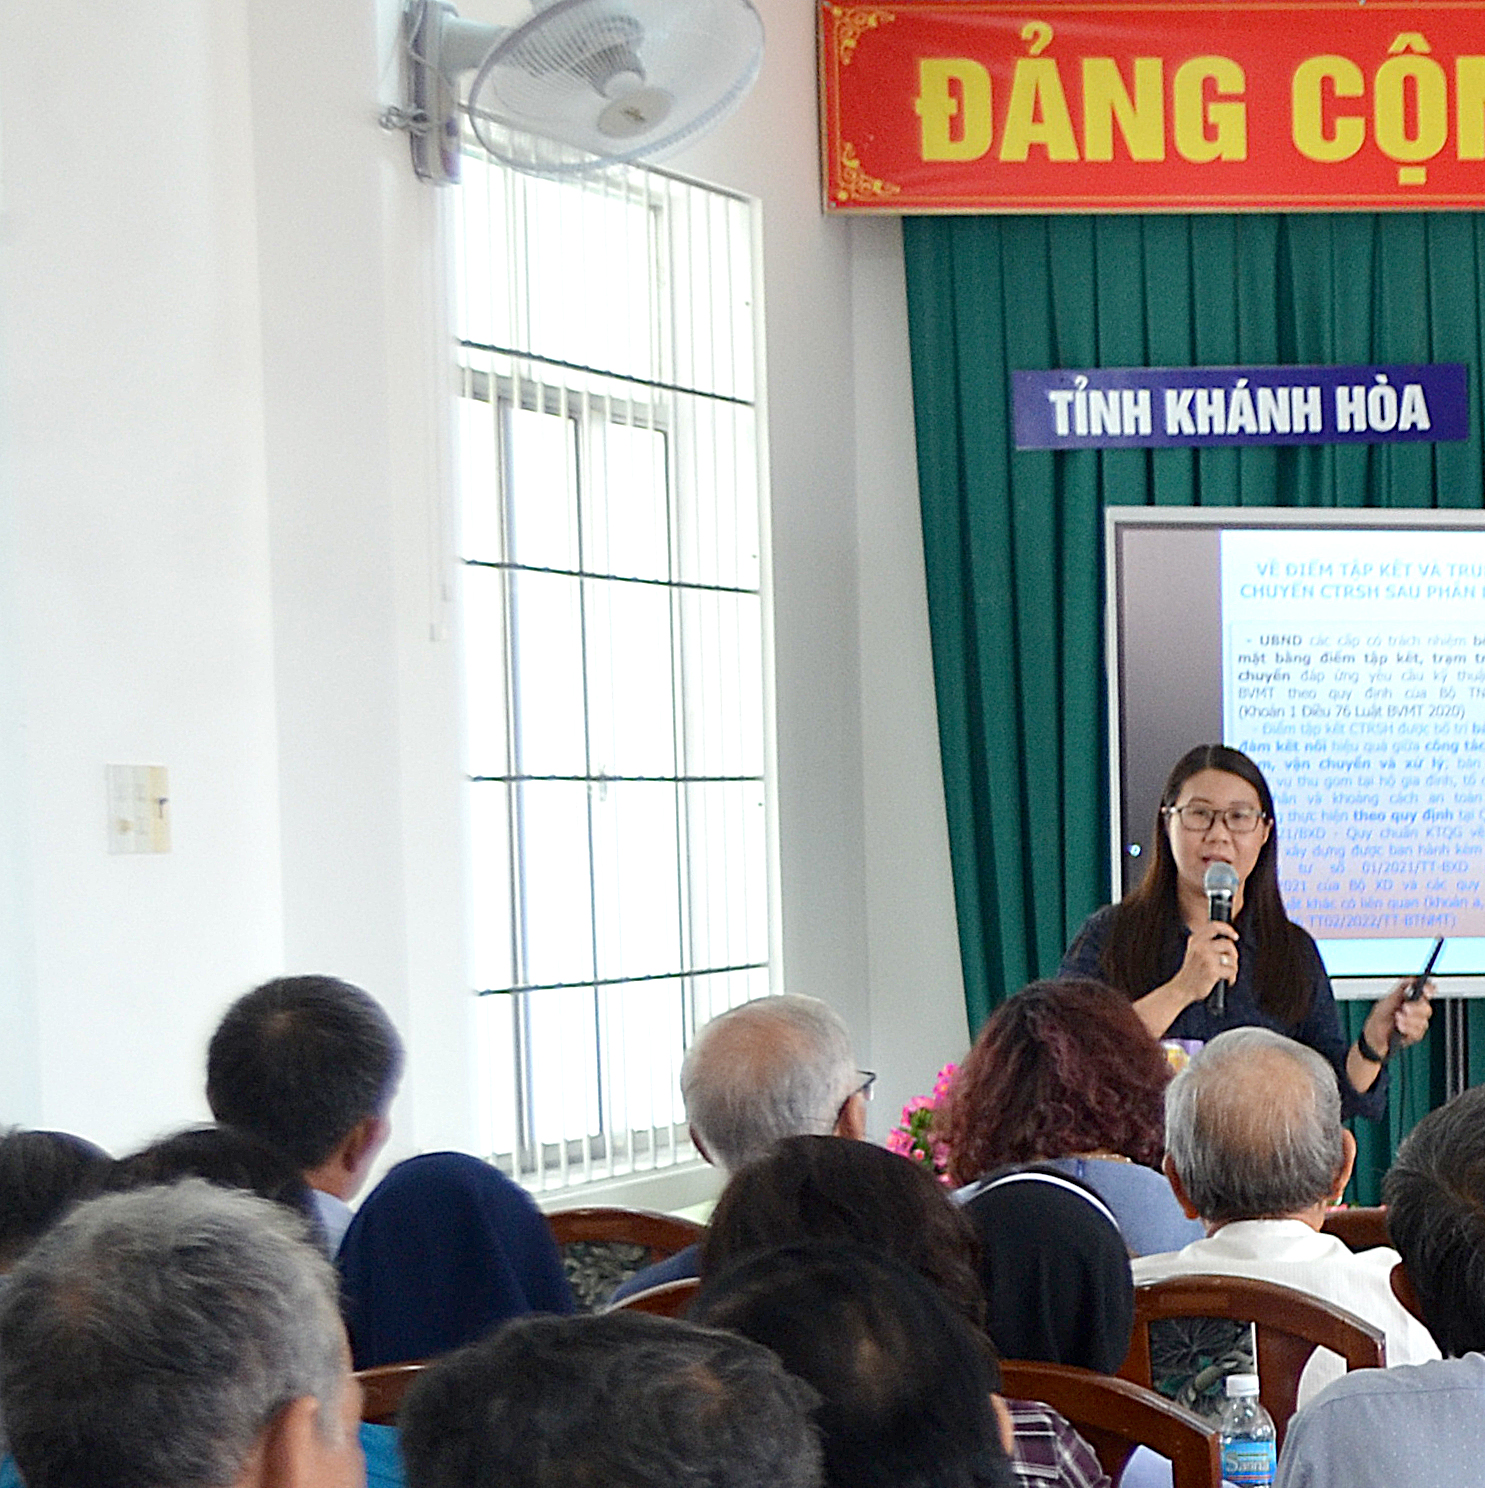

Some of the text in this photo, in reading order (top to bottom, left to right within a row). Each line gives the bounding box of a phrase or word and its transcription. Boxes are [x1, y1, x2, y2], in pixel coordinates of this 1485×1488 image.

[915, 22, 1247, 161] ĐẢNG
[1050, 375, 1431, 437] TỈNH KHÁNH HÒA
